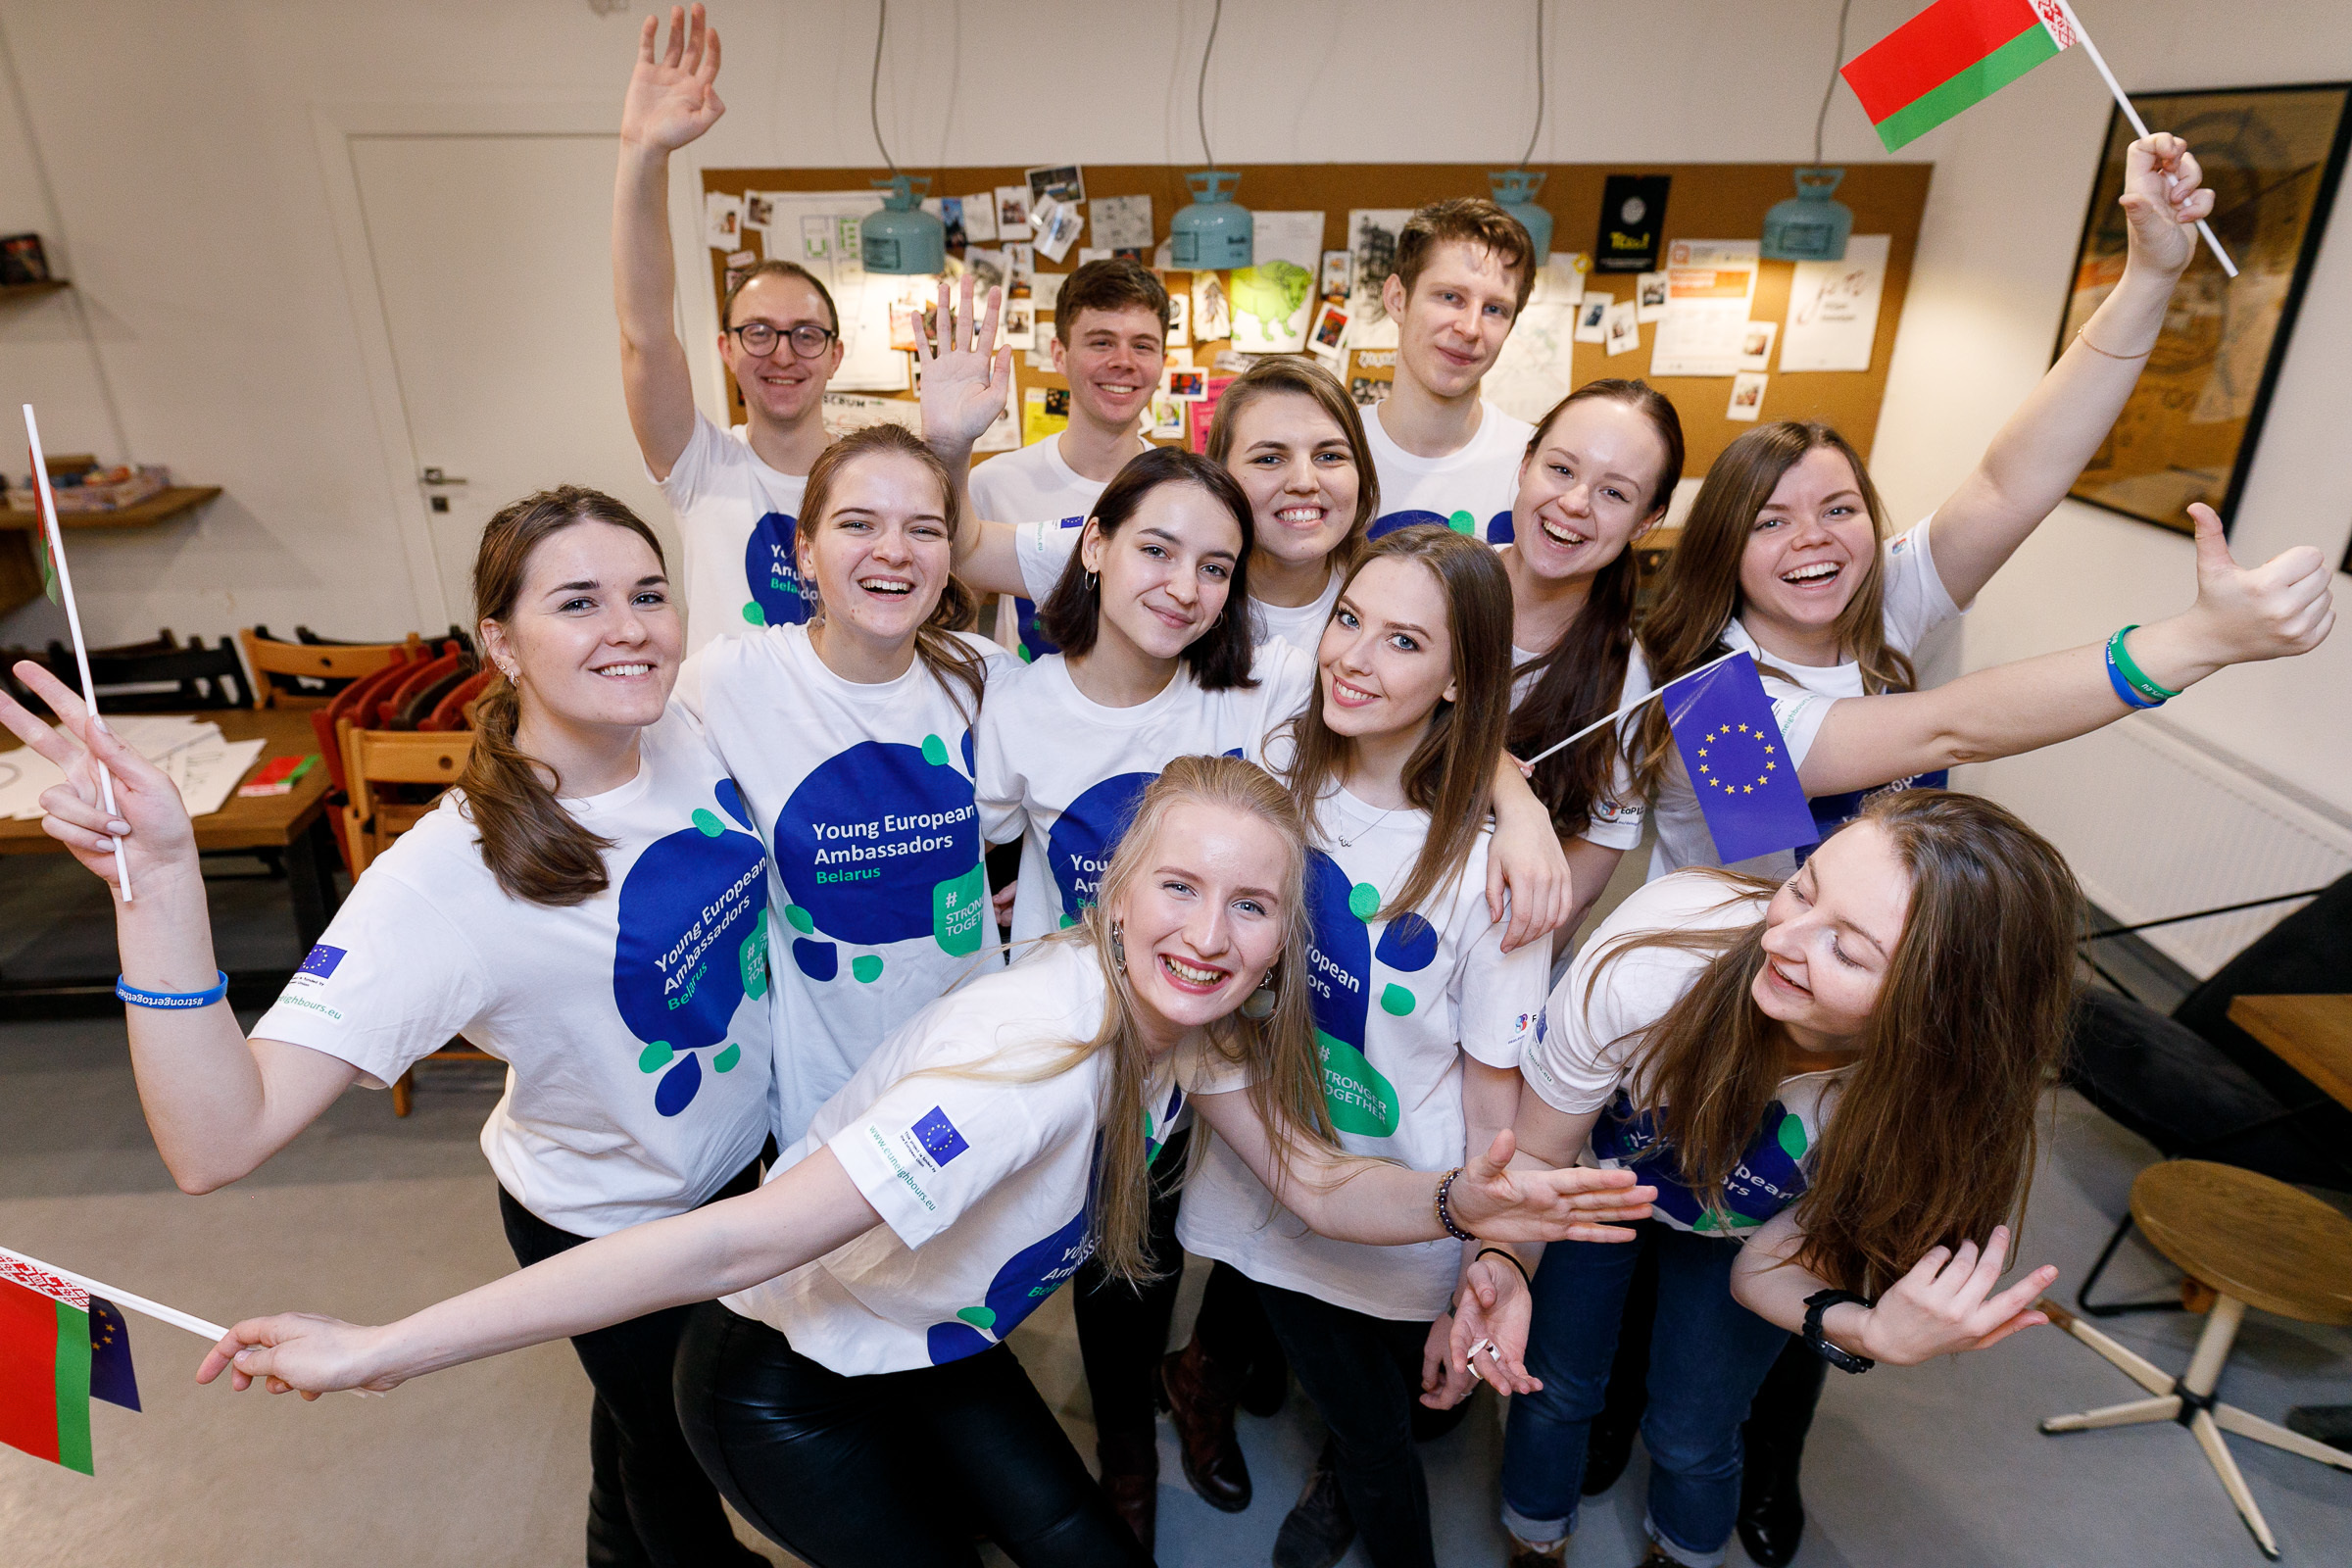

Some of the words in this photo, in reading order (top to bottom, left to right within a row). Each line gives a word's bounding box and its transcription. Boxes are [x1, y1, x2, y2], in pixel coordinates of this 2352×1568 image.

[811, 821, 880, 841] Young
[884, 804, 975, 833] European
[813, 835, 954, 865] Ambassadors
[815, 867, 881, 884] Belarus
[654, 919, 703, 973] Young
[702, 856, 766, 926] European
[945, 891, 957, 908] #
[945, 896, 984, 925] STRON
[663, 894, 751, 996] Ambassadors
[118, 987, 204, 1007] #strongertogether
[666, 961, 708, 1011] Belarus
[1306, 974, 1332, 999] ors
[869, 1125, 937, 1211] www.euneighbours.eu
